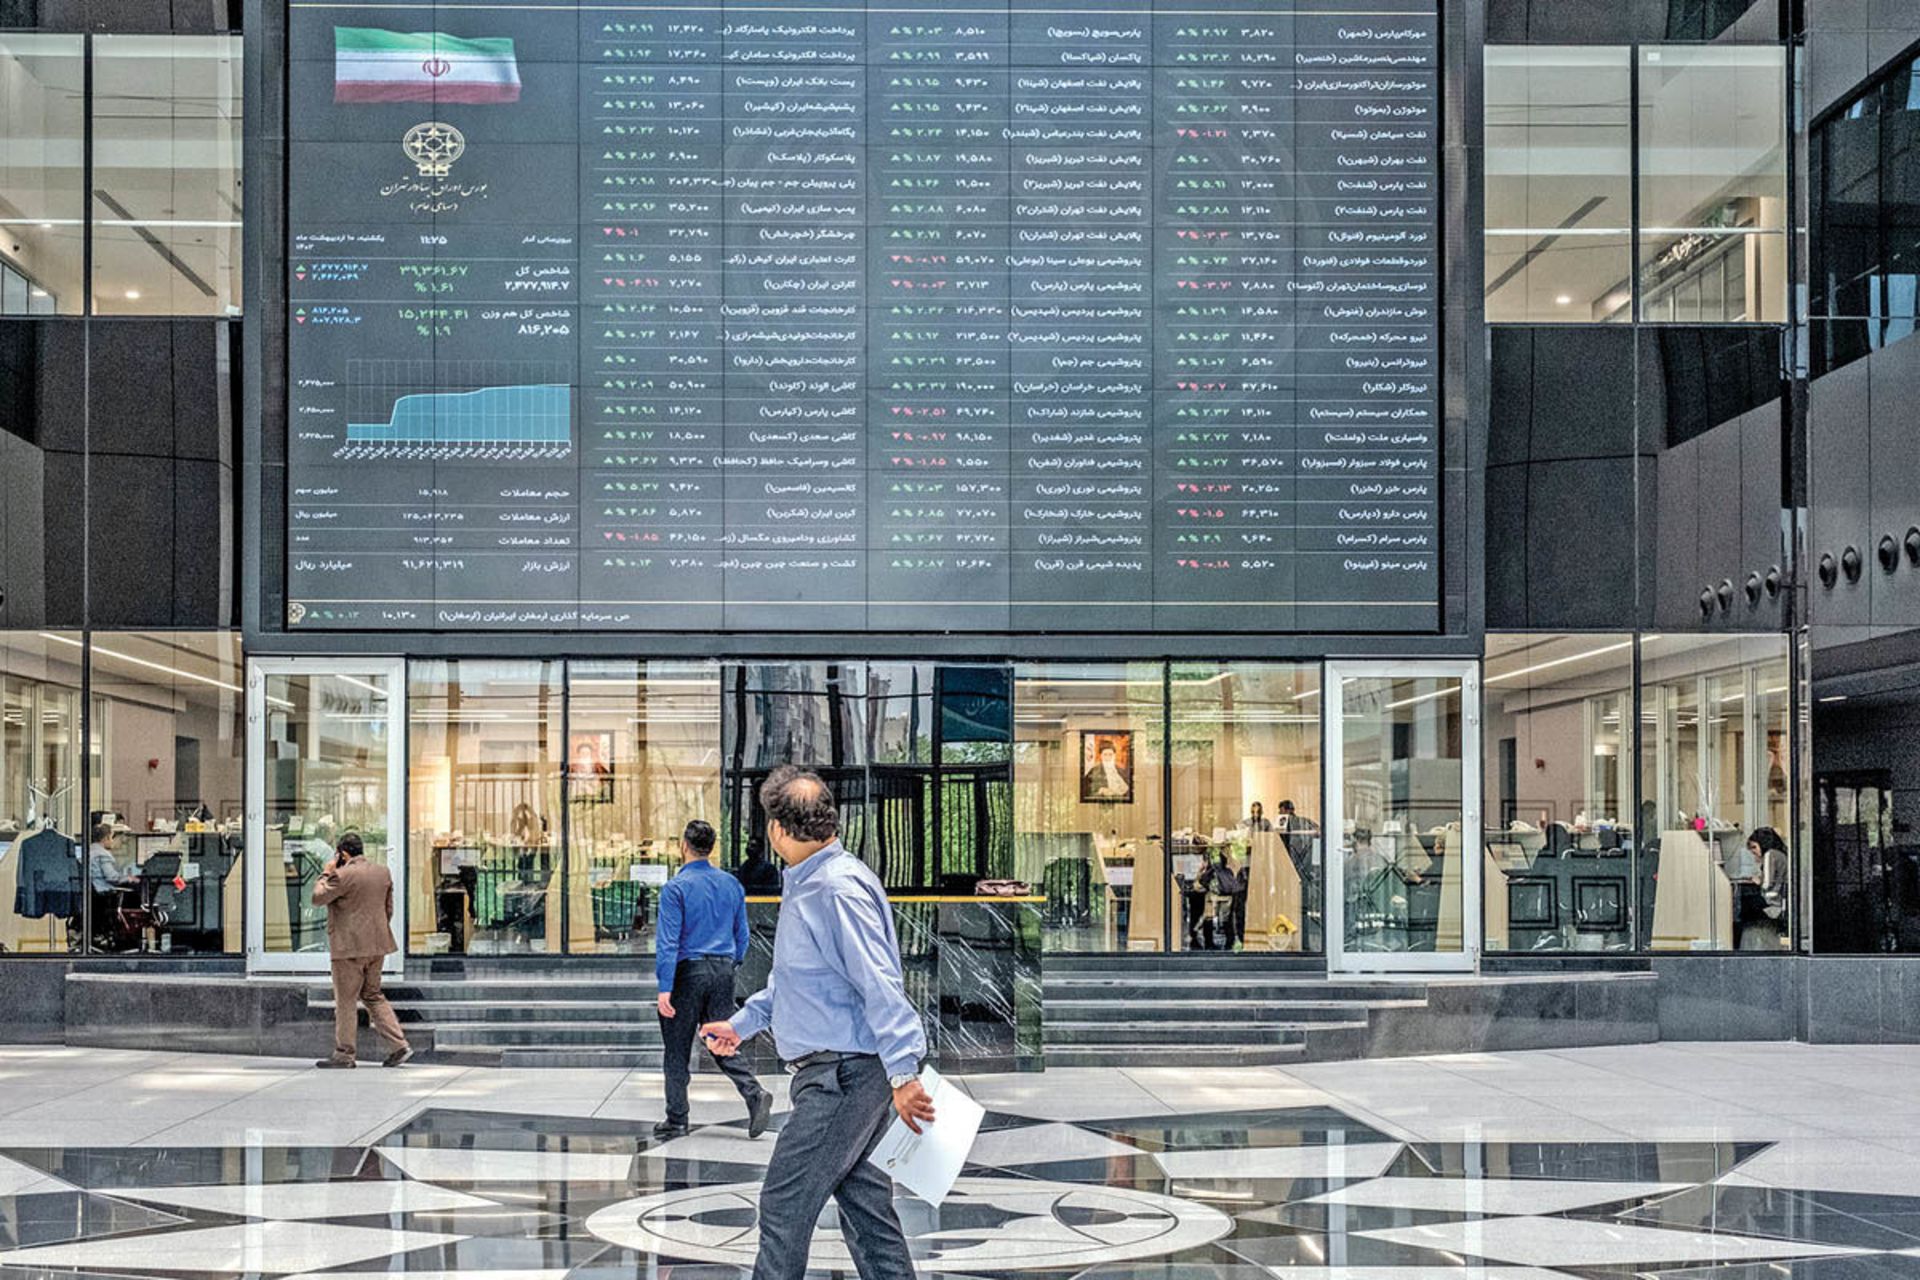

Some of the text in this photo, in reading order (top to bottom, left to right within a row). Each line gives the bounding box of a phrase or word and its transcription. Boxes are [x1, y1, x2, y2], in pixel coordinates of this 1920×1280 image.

[736, 25, 855, 36] پرداخت الکترونیک پاسارگاد
[741, 51, 855, 61] پرداخت الکترونیک سامان
[1108, 53, 1141, 63] پاکسان
[781, 76, 855, 88] پست بانک ایران
[1051, 80, 1084, 89] اصفهان
[1110, 80, 1141, 89] پالایش
[1051, 104, 1084, 114] اصفهان
[1110, 105, 1141, 114] پالایش
[1042, 130, 1084, 139] بندرعباس
[1110, 130, 1141, 140] پالایش
[1370, 131, 1404, 140] سپاهان
[1064, 156, 1084, 164] تبریز
[1110, 156, 1141, 165] پالایش
[839, 179, 855, 189] پلی
[1064, 181, 1084, 190] تبریز
[1110, 181, 1141, 190] پالایش
[1379, 182, 1403, 191] پارس
[783, 204, 832, 214] سازی ایران
[1060, 206, 1084, 215] تهران
[1110, 206, 1141, 216] پالایش
[1380, 207, 1404, 216] پارس
[1060, 232, 1084, 241] تهران
[1110, 232, 1141, 241] پالایش
[1366, 232, 1428, 242] نورد آلومینیوم
[749, 255, 855, 265] کارت اعتباری ایران کیش
[1046, 257, 1141, 266] پتروشیمی بوعلی سینا
[1339, 257, 1370, 267] فولادی
[516, 266, 570, 278] شاخص کل
[807, 281, 829, 290] ایران
[1070, 282, 1141, 291] پتروشیمی پارس
[520, 310, 533, 319] کل
[538, 310, 570, 319] شاخص
[762, 305, 855, 315] کارخانجات قزوین
[1062, 308, 1141, 317] پتروشیمی پردیس
[1365, 308, 1428, 317] نوش مازندران
[482, 311, 500, 319] وزن
[1062, 333, 1141, 343] پتروشیمی پردیس
[1410, 334, 1427, 343] نیرو
[1097, 358, 1142, 367] پتروشیمی
[832, 382, 856, 392] کاشی
[1061, 383, 1141, 393] پتروشیمی خراسان
[804, 408, 856, 417] کاشی پارس
[1071, 409, 1141, 418] پتروشیمی شازند
[1356, 408, 1427, 418] همکاران سیستم
[832, 433, 856, 442] کاشی
[1097, 434, 1141, 443] پتروشیمی
[832, 458, 855, 467] کاشی
[1097, 459, 1141, 468] پتروشیمی
[1348, 459, 1427, 469] پارس فولاد سبزوار
[314, 487, 337, 495] میلیون
[1072, 485, 1141, 495] پتروشیمی نوری
[1402, 485, 1427, 495] پارس
[296, 510, 310, 519] ریال
[544, 513, 570, 523] ارزش
[811, 509, 832, 519] ایران
[1070, 510, 1141, 519] پتروشیمی خارک
[1383, 510, 1427, 520] پارس دارو
[545, 536, 571, 545] تعداد
[818, 534, 856, 544] کشاورزی
[1403, 535, 1427, 544] پارس
[295, 560, 352, 570] میلیارد ریال
[522, 561, 570, 572] ارزش بازار
[1066, 560, 1084, 570] قرن
[1086, 561, 1113, 570] شیمی
[1403, 561, 1427, 570] پارس
[483, 612, 516, 621] ایرانیان
[518, 612, 548, 621] ارمغان
[550, 611, 577, 622] گذاری
[582, 612, 611, 621] سرمایه
